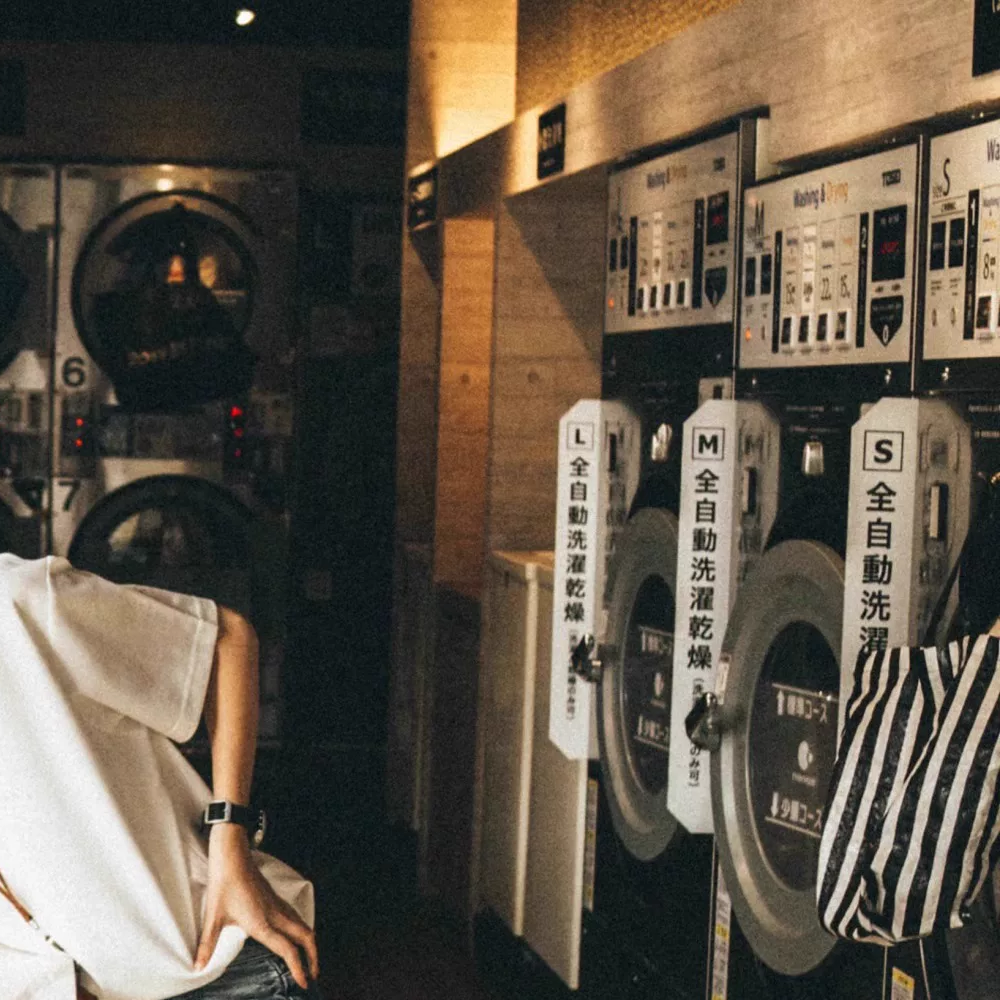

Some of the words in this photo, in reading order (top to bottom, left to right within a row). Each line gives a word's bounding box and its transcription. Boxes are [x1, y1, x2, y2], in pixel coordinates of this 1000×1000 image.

[62, 357, 86, 387] 6
[575, 428, 585, 444] L
[698, 434, 718, 454] M
[873, 439, 893, 464] S
[58, 481, 80, 511] 7
[564, 456, 590, 622] 全自動洗濯乾燥
[687, 468, 719, 670] 全自動洗濯乾燥
[859, 481, 897, 653] 全自動洗濯
